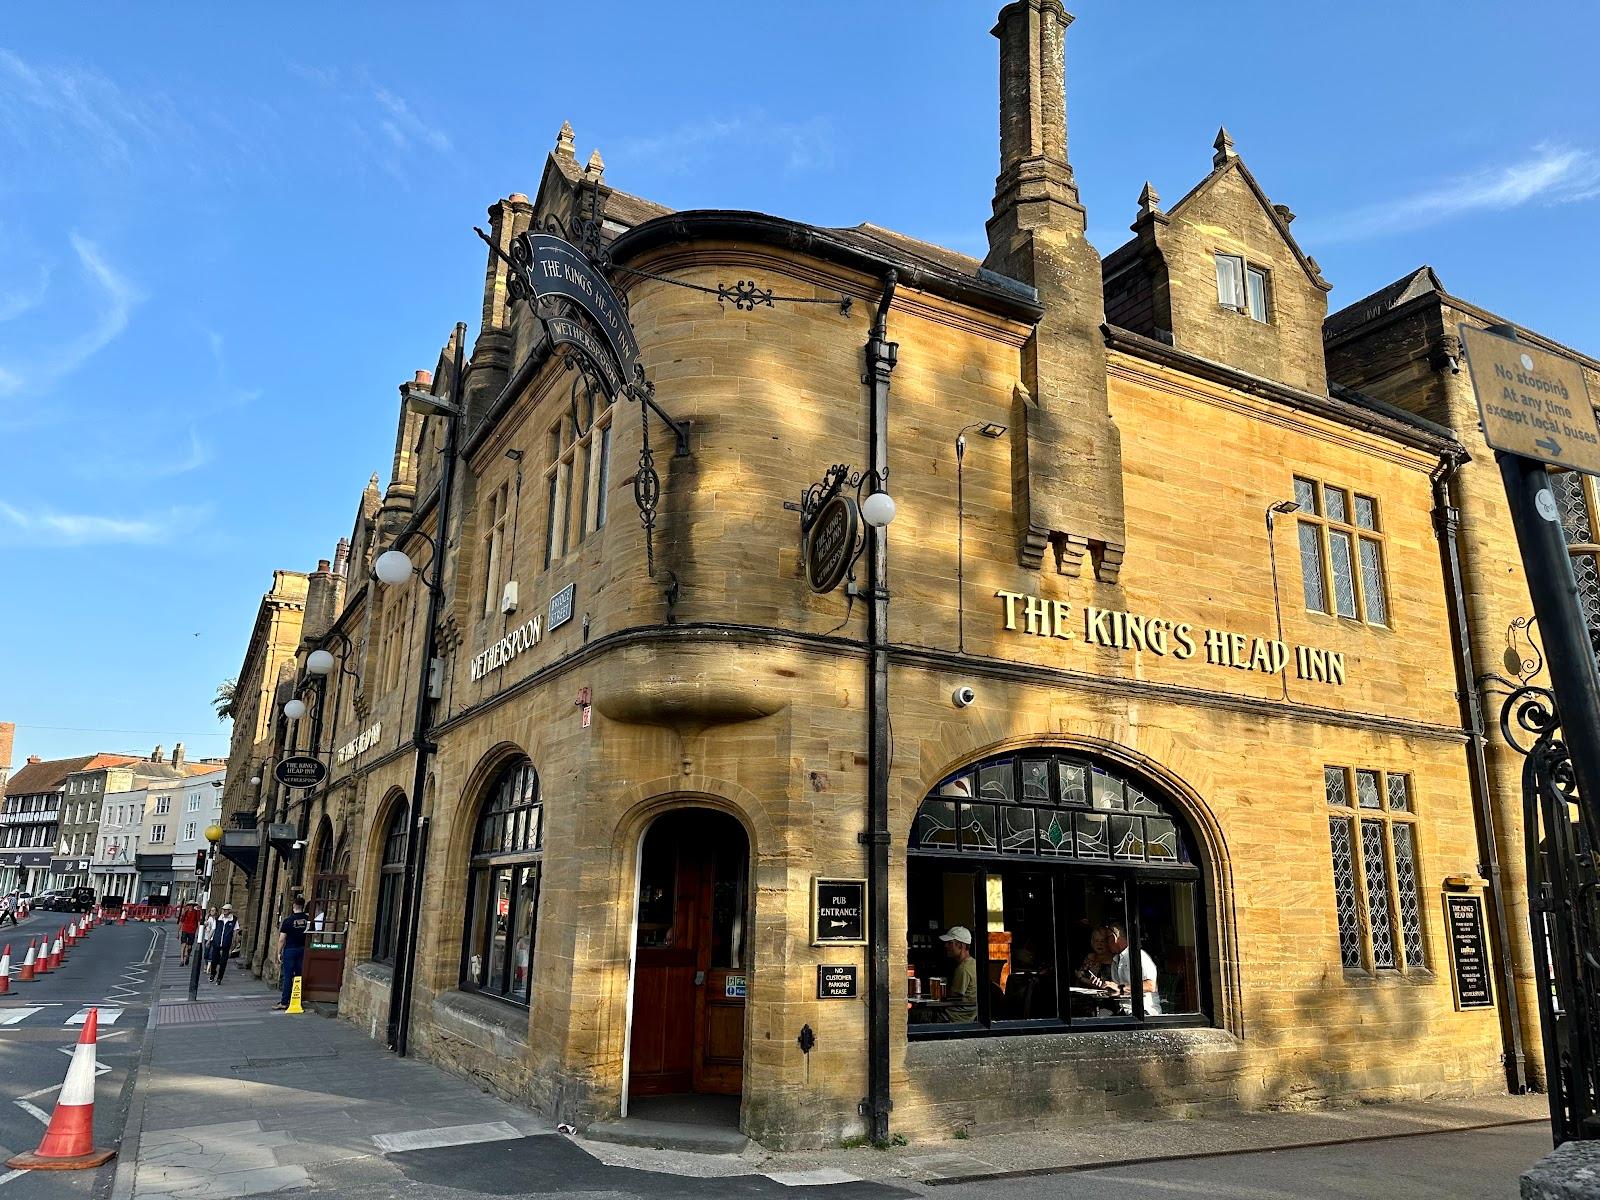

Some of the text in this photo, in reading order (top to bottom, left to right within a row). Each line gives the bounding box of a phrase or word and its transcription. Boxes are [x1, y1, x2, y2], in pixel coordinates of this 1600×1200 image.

[540, 260, 631, 360] THE KING'S HEAD INN
[553, 322, 617, 385] WETHERSPOON
[1494, 363, 1569, 400] No stopping
[1503, 387, 1572, 419] At any time
[1486, 404, 1597, 444] except local buses
[550, 604, 569, 625] STREET
[470, 614, 544, 682] WETHERSPOON
[995, 589, 1346, 686] THE KING'S HEAD INN
[820, 908, 858, 917] ENTRANCE
[832, 896, 847, 905] PUB
